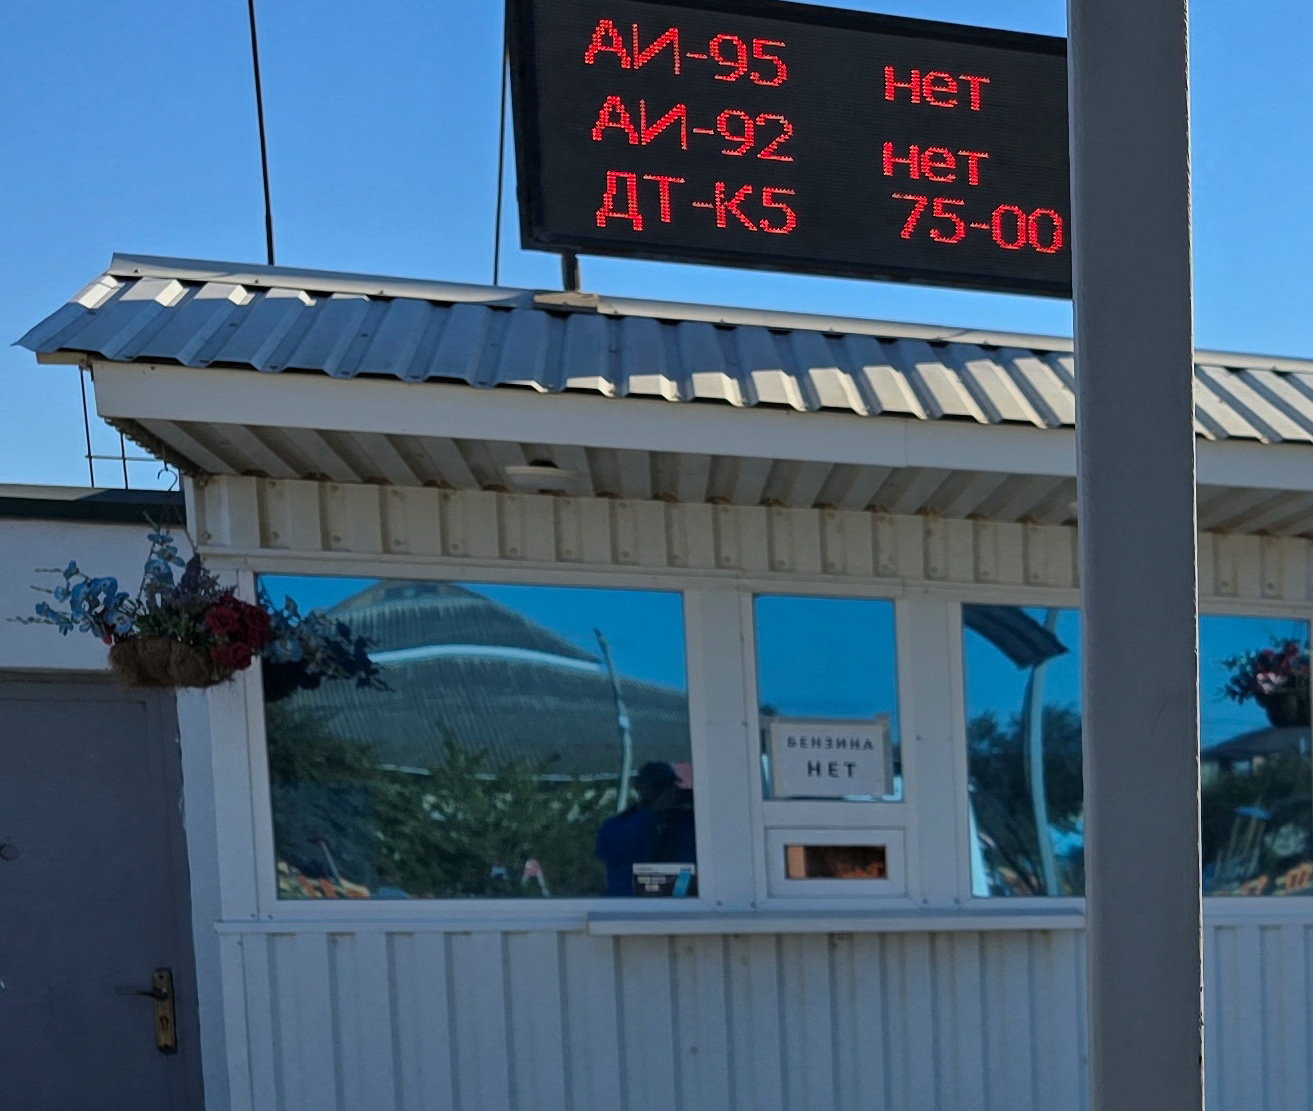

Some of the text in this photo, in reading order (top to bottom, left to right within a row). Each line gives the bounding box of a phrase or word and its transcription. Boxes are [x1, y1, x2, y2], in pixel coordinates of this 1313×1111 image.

[584, 18, 991, 112] АИ-95 нет
[591, 95, 989, 186] АИ-92 нет
[595, 170, 1063, 253] ДТ-К5 75-00
[786, 735, 875, 751] БЕНЗИНА
[807, 760, 857, 778] НЕТ
